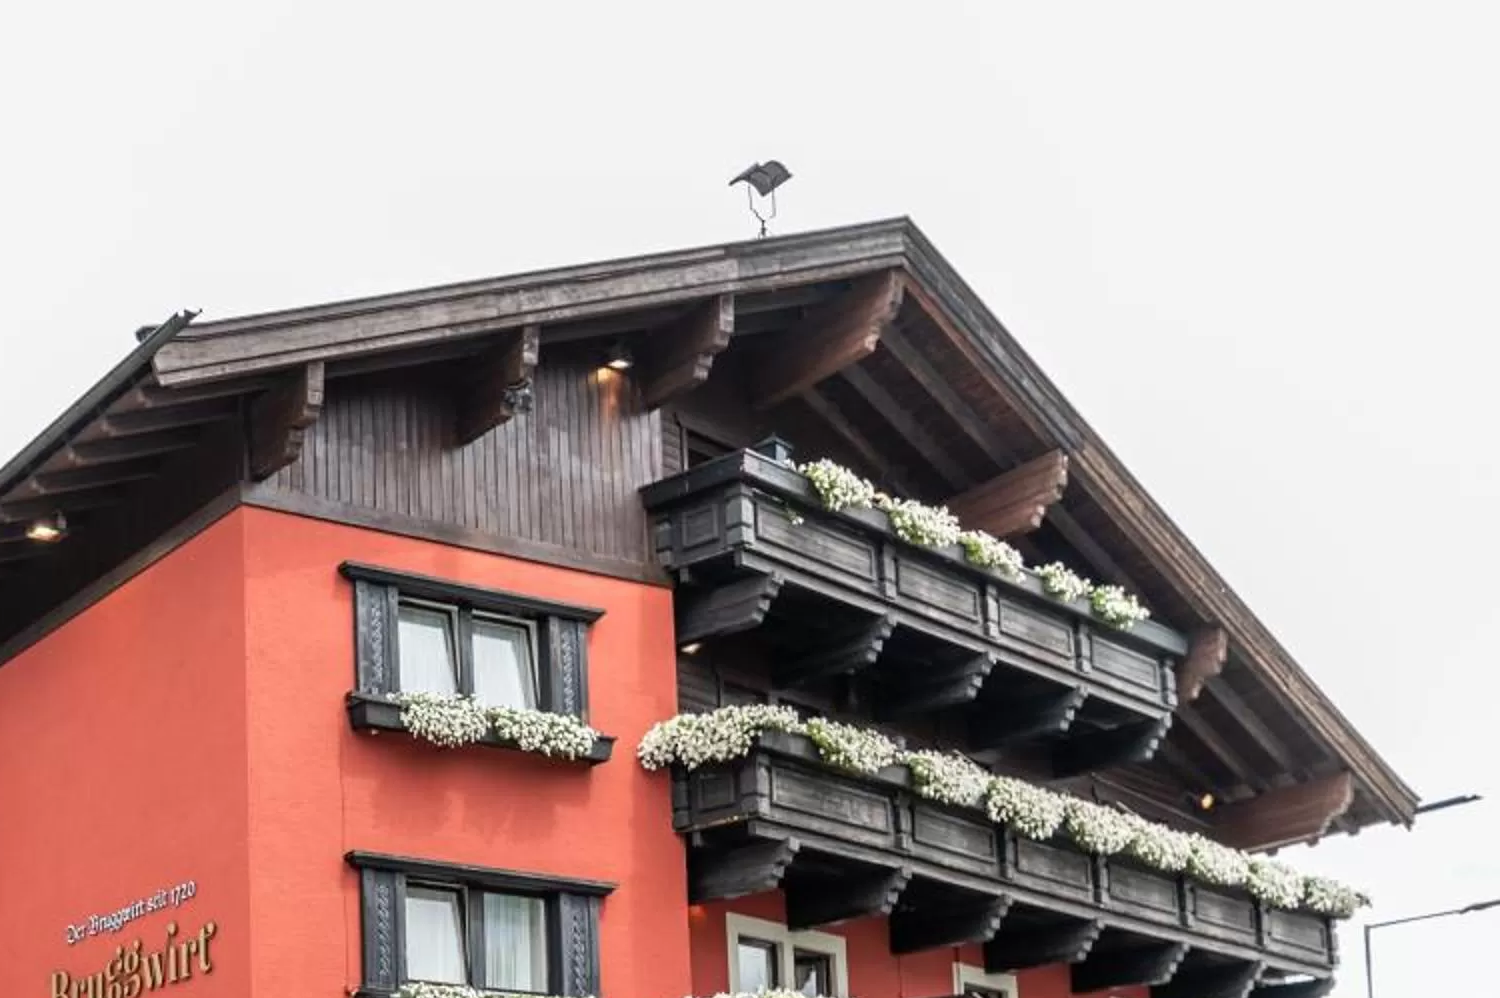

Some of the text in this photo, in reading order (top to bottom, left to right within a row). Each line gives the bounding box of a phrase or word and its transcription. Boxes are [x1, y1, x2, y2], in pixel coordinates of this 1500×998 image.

[66, 923, 85, 944] Der
[147, 889, 168, 913] seit
[170, 880, 197, 907] 1720
